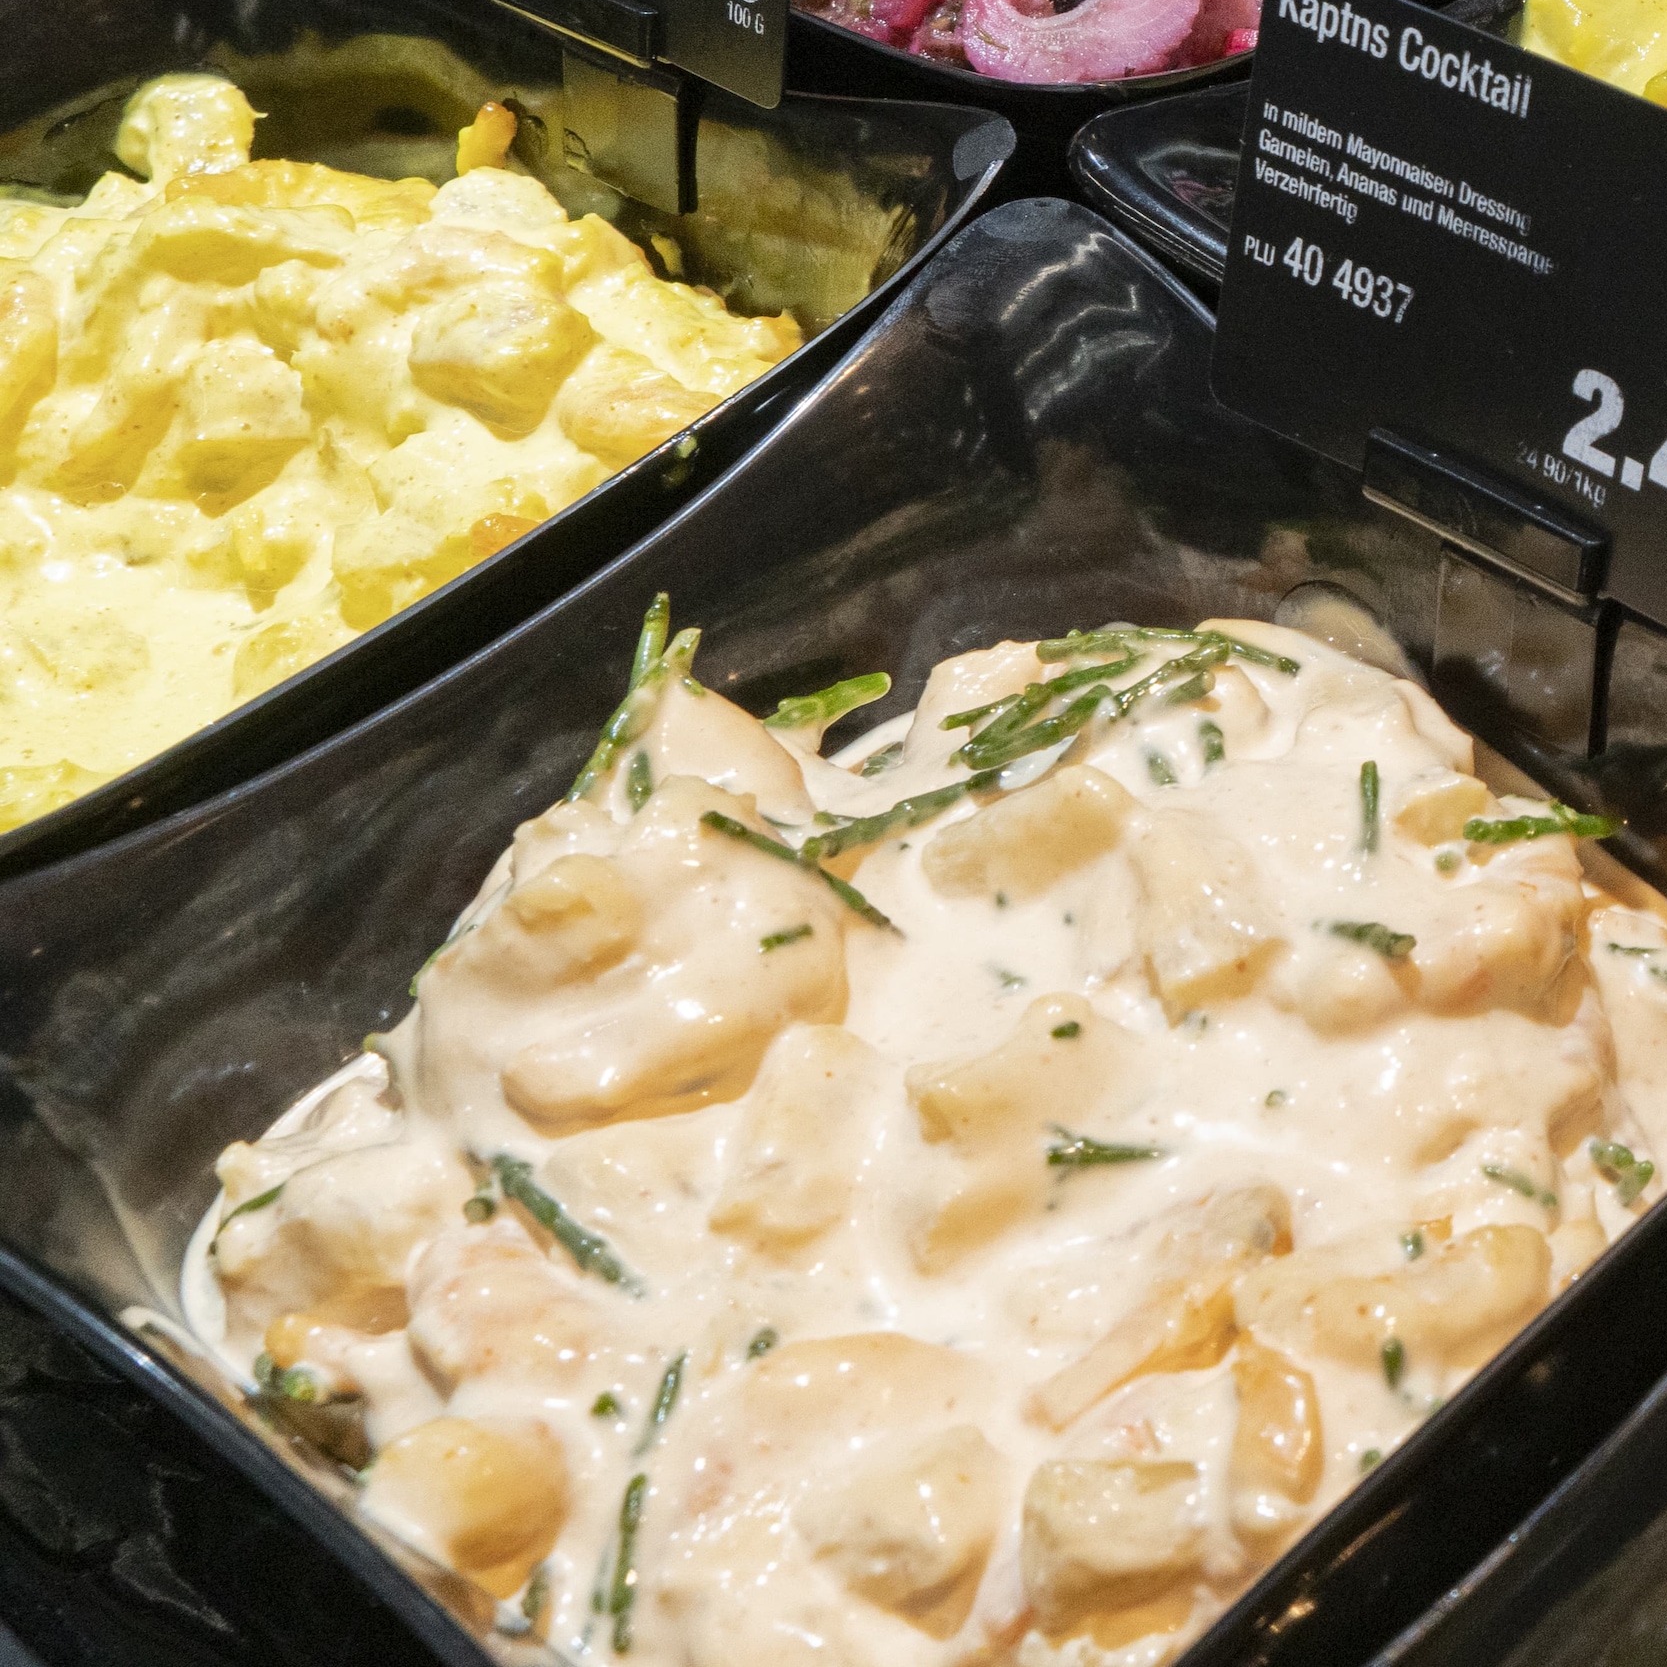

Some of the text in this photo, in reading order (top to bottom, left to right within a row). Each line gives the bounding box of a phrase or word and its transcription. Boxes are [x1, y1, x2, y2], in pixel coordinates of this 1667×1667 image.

[727, 0, 750, 29] 100
[1399, 27, 1532, 119] Cocktail
[1255, 157, 1358, 224] Verzehrfertig
[1259, 129, 1398, 207] Garnelen, Ananas
[1282, 111, 1531, 236] mildem Mayonnaisen Dressing
[1244, 234, 1415, 325] PLU 40 4937
